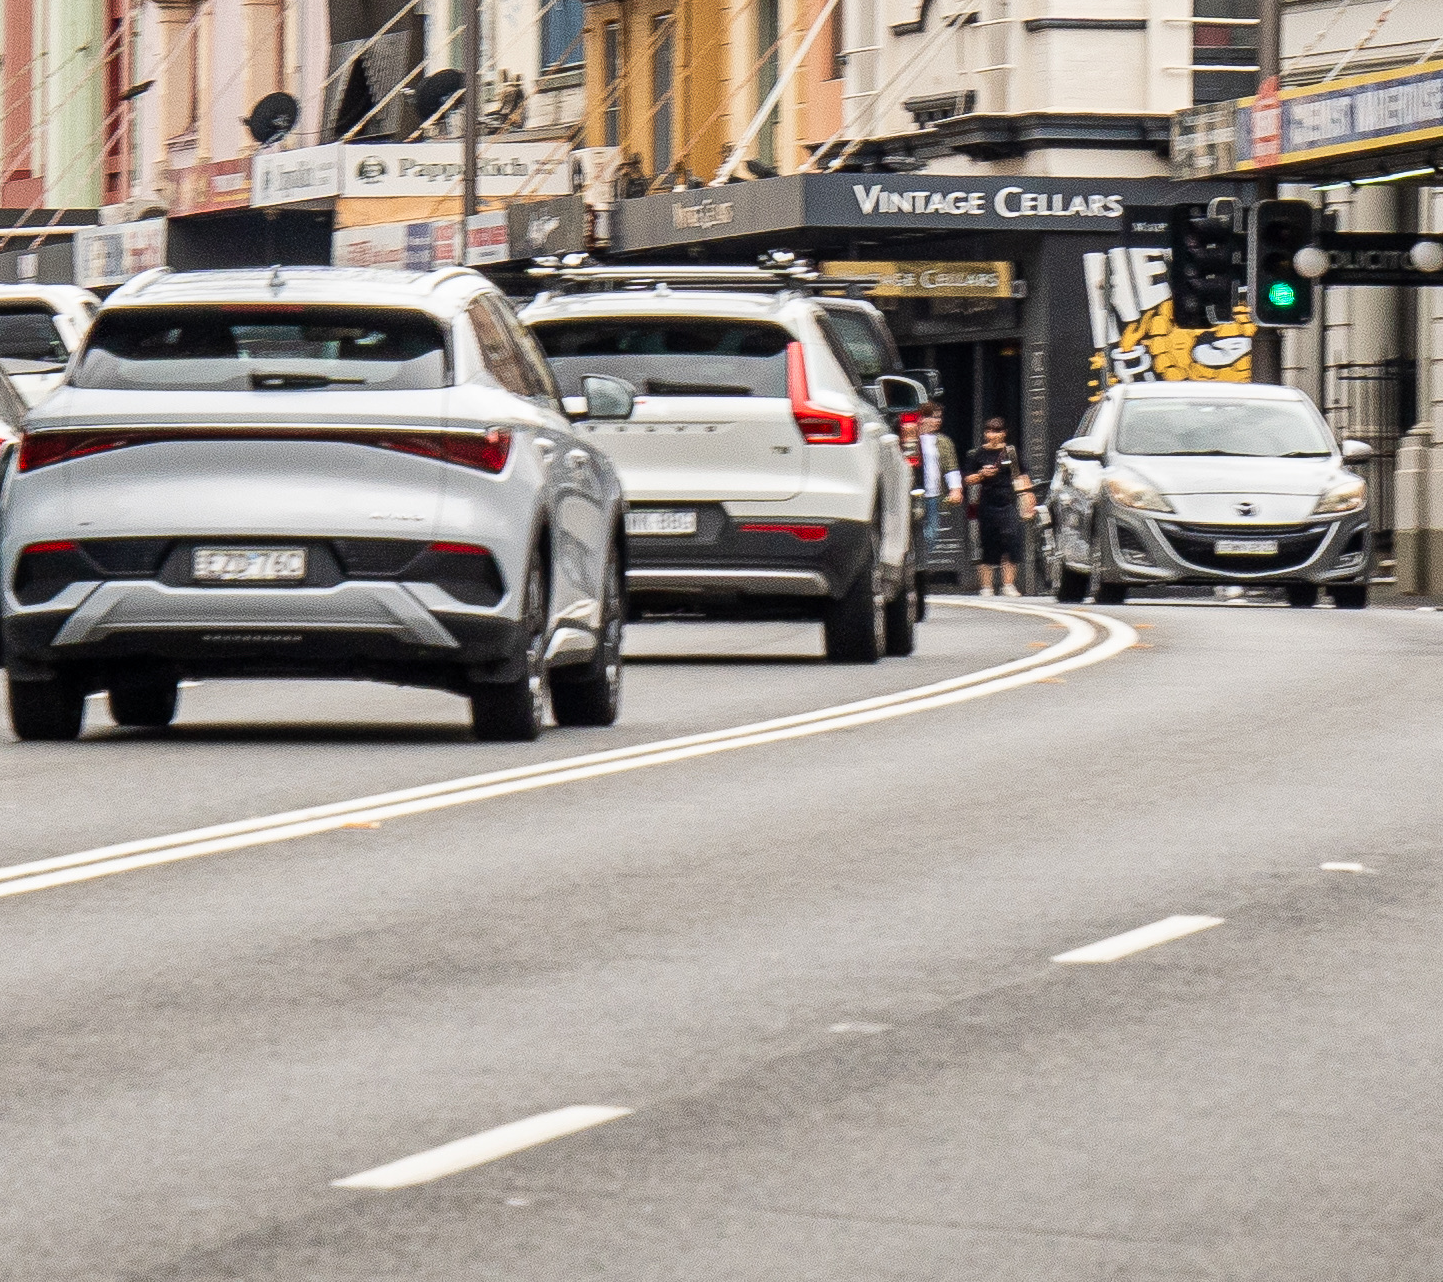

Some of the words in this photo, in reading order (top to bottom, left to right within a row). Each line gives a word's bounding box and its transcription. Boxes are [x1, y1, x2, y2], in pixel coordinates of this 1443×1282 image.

[397, 155, 530, 179] PappRich
[852, 184, 986, 215] VINTAGE
[993, 185, 1124, 218] CELLARS
